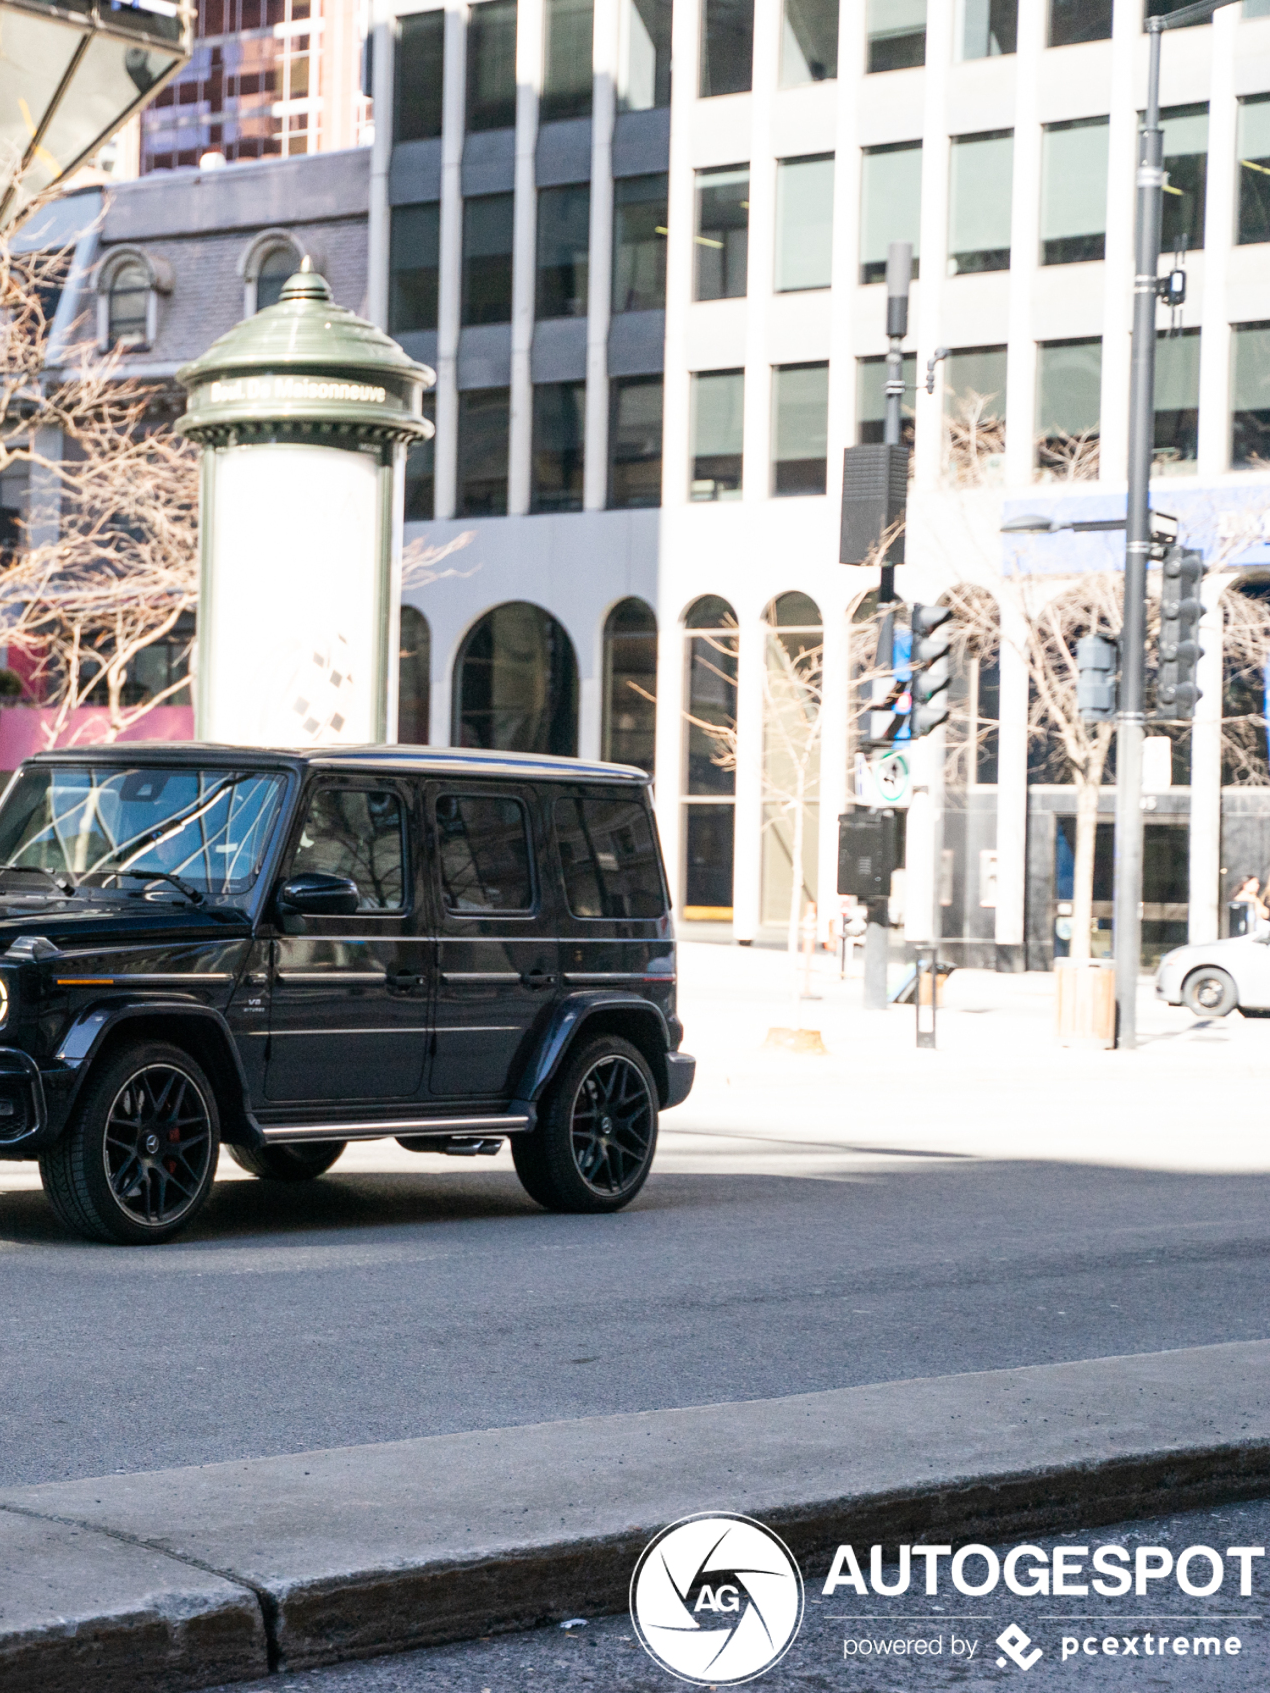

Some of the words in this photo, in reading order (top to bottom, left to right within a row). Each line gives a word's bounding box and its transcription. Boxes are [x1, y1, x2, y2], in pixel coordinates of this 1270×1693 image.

[211, 380, 246, 403] Boul.
[247, 378, 271, 400] De
[274, 378, 387, 404] Maisonneuve
